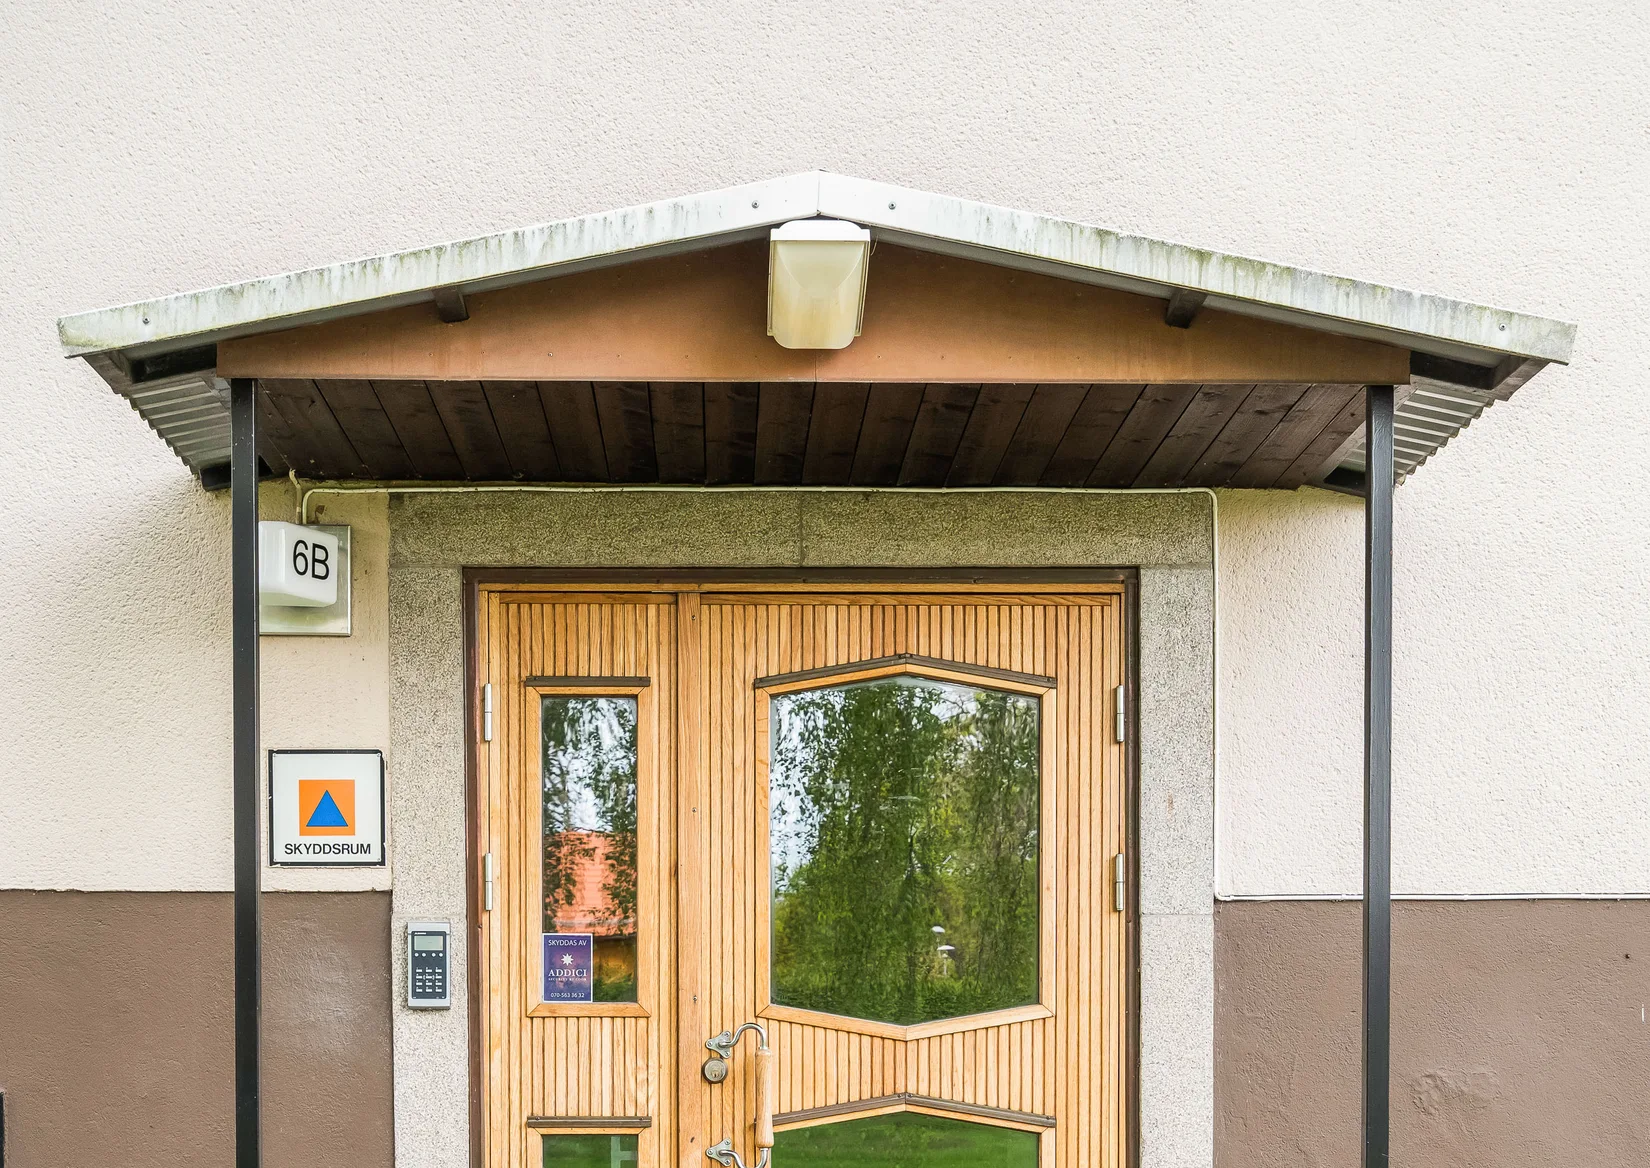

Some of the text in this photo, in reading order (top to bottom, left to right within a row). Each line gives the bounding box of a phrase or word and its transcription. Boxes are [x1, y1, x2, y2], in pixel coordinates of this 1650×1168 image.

[293, 539, 330, 580] 6B
[284, 843, 371, 855] SKYDDSRUM
[548, 969, 587, 977] ADDICI
